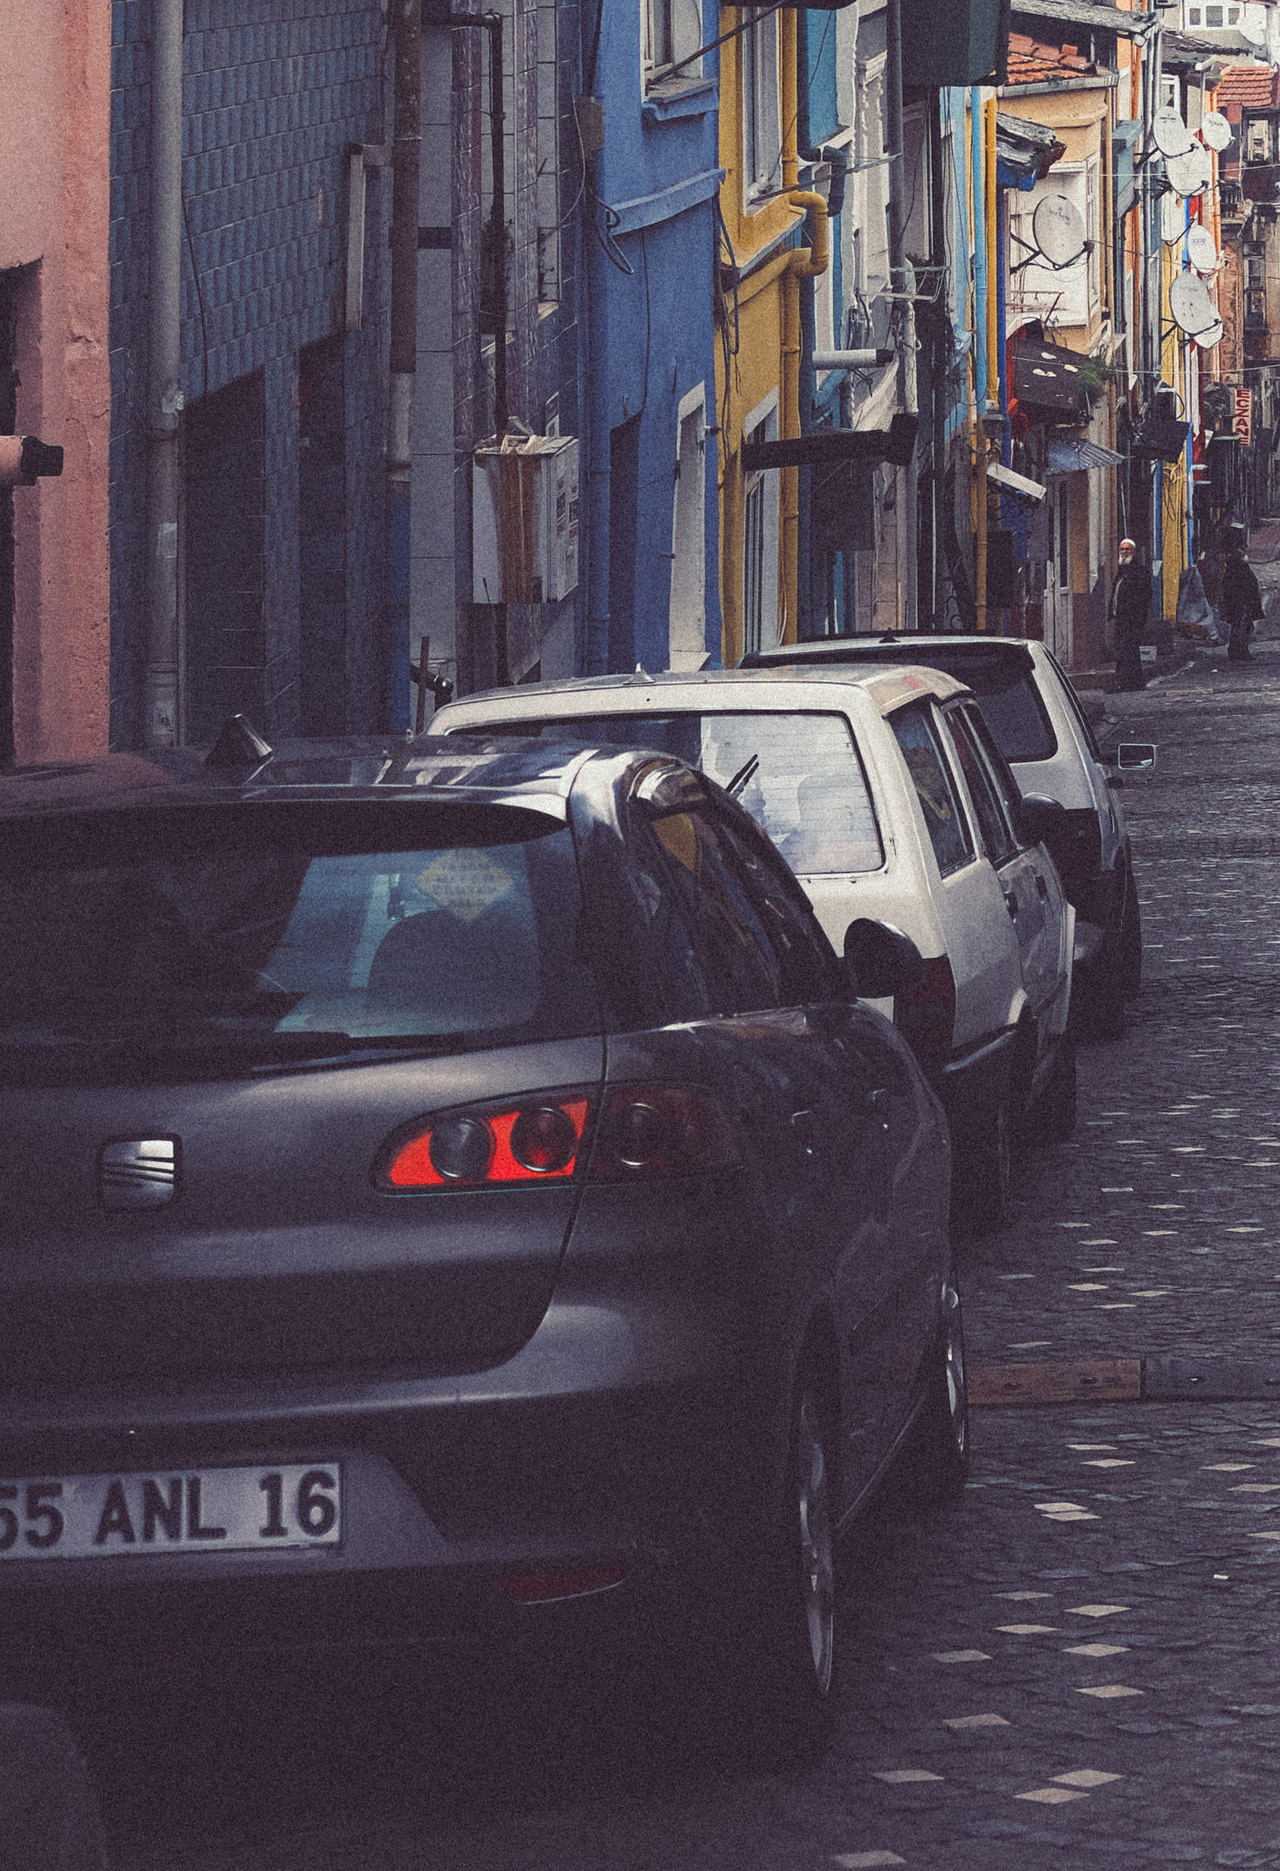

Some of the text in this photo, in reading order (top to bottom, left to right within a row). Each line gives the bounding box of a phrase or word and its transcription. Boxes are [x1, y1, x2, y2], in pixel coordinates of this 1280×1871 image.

[1235, 389, 1250, 446] ECZANE
[96, 1476, 227, 1544] ANL
[258, 1470, 337, 1538] 16
